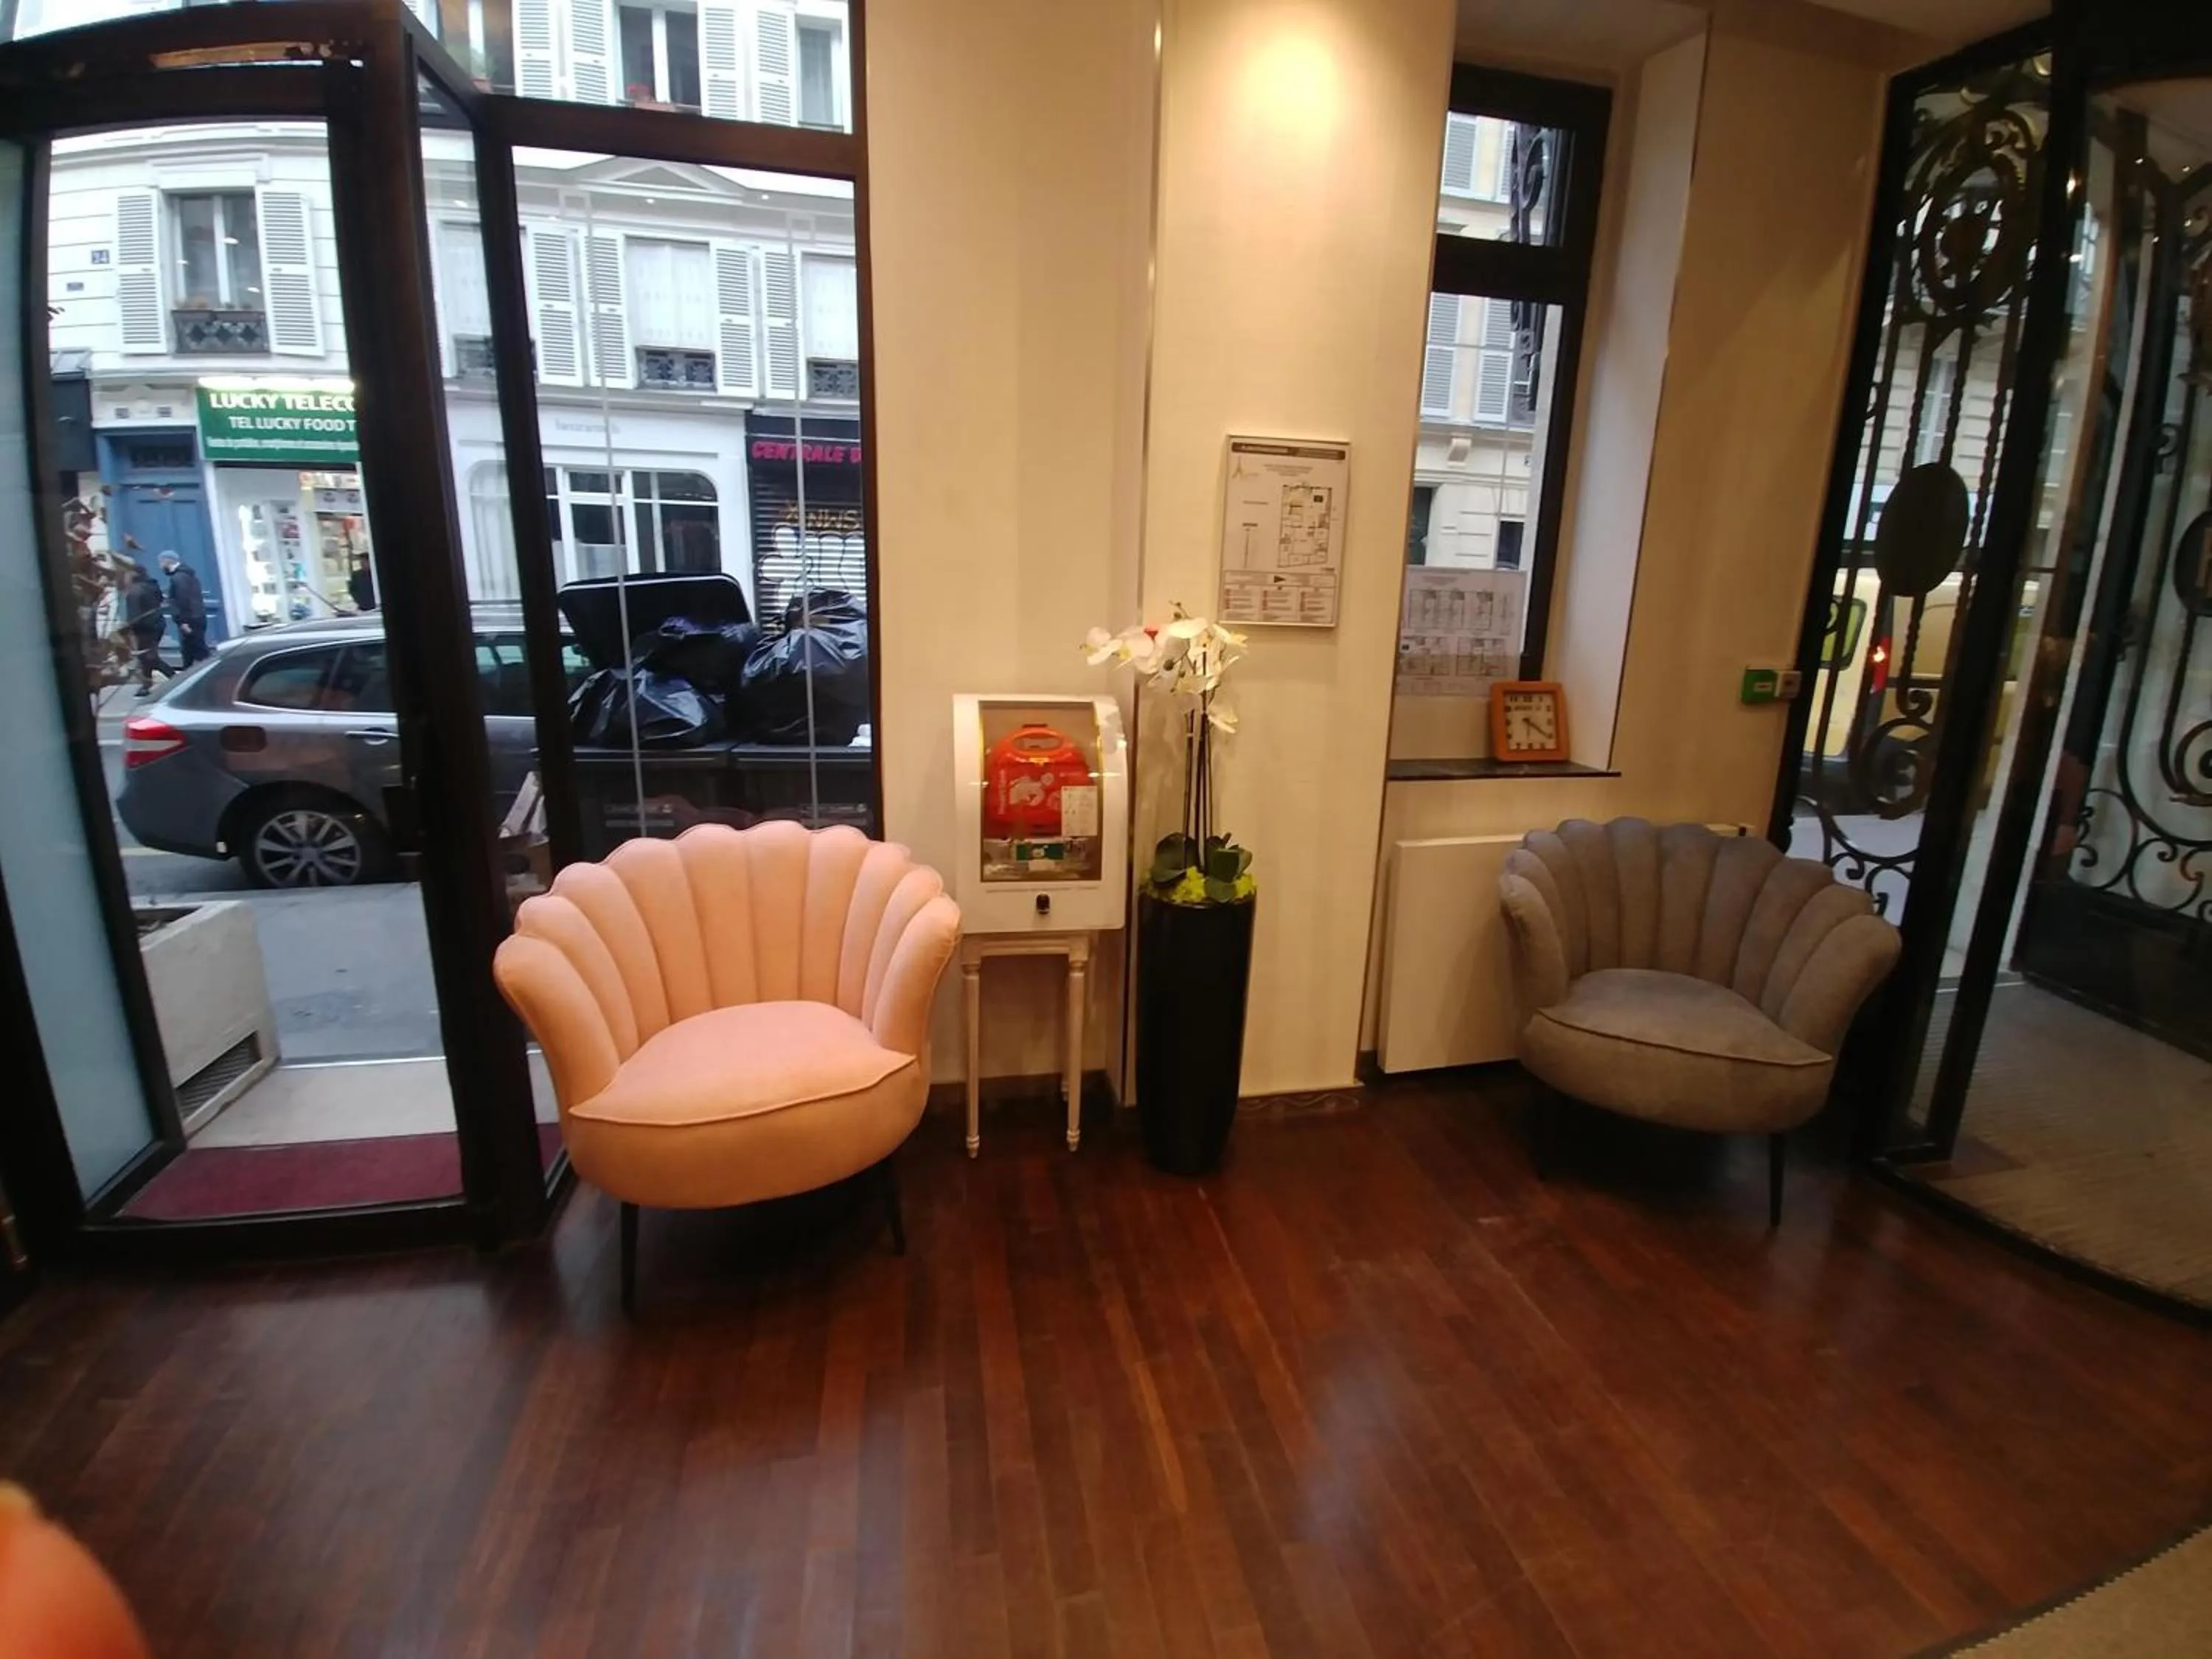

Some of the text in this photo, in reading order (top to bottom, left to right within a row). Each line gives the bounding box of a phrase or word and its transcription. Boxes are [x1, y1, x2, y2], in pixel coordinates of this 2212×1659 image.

[209, 393, 277, 409] LUCKY
[229, 416, 254, 428] TEL
[257, 417, 300, 430] LUCKY
[304, 418, 346, 431] FOOD
[751, 440, 846, 464] CENTRALE
